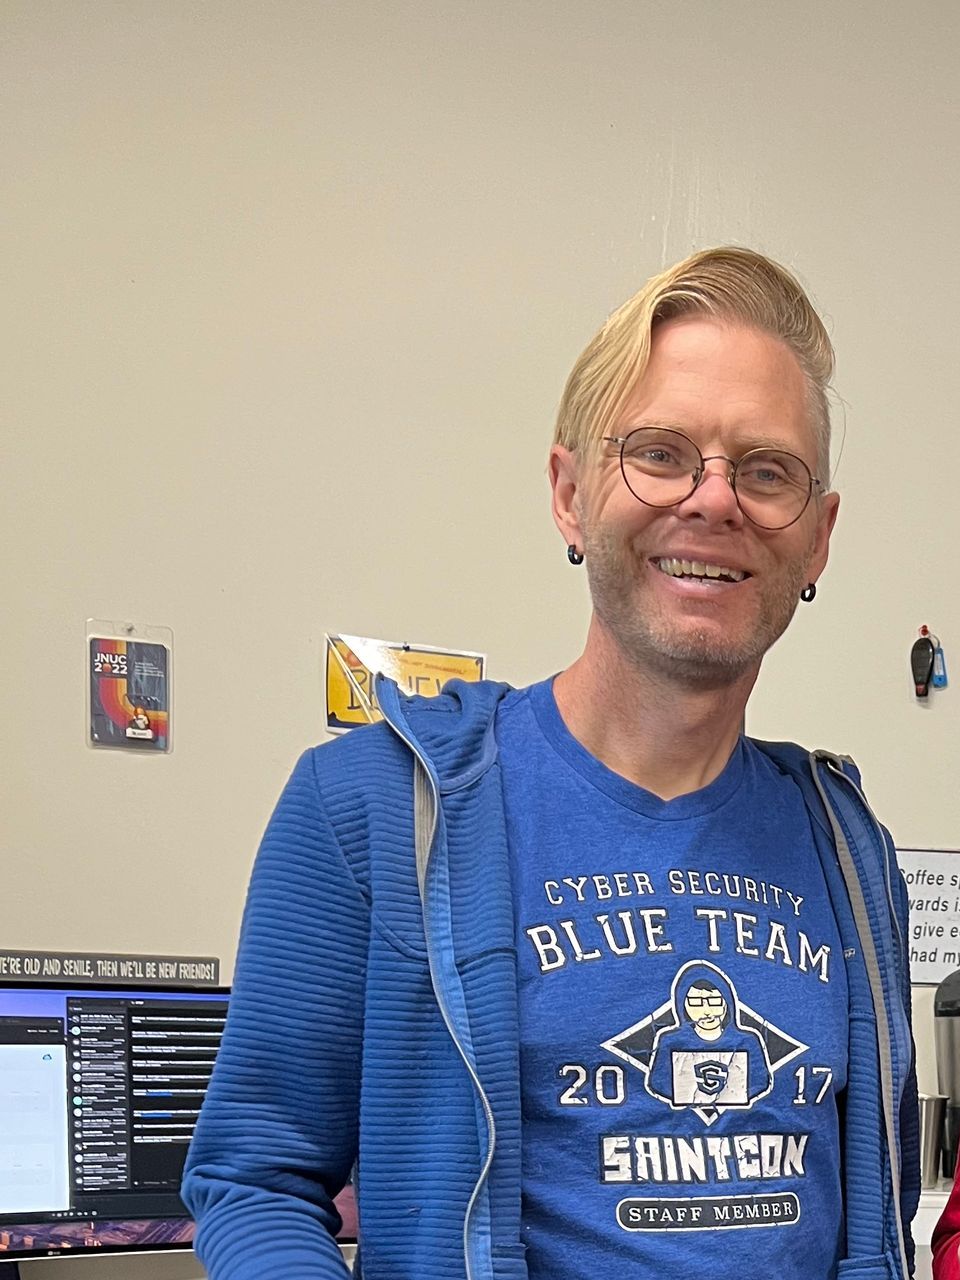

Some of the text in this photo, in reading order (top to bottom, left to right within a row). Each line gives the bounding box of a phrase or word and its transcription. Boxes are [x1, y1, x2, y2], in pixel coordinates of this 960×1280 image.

[94, 653, 127, 665] JNUC
[544, 870, 804, 916] CYBER SECURITY
[913, 922, 945, 940] give
[527, 908, 831, 982] BLUE TEAM
[909, 947, 938, 963] had
[24, 957, 40, 975] OLD
[42, 958, 61, 976] AND
[63, 959, 94, 978] SENILE,
[97, 960, 118, 977] THEN
[120, 961, 144, 978] WE'LL
[145, 962, 157, 979] BE
[158, 962, 178, 979] NEW
[179, 962, 215, 980] FRIENDS!
[558, 1065, 833, 1105] 20 17
[602, 1135, 809, 1182] SAINTCON
[628, 1202, 793, 1223] STAFF MEMBER
